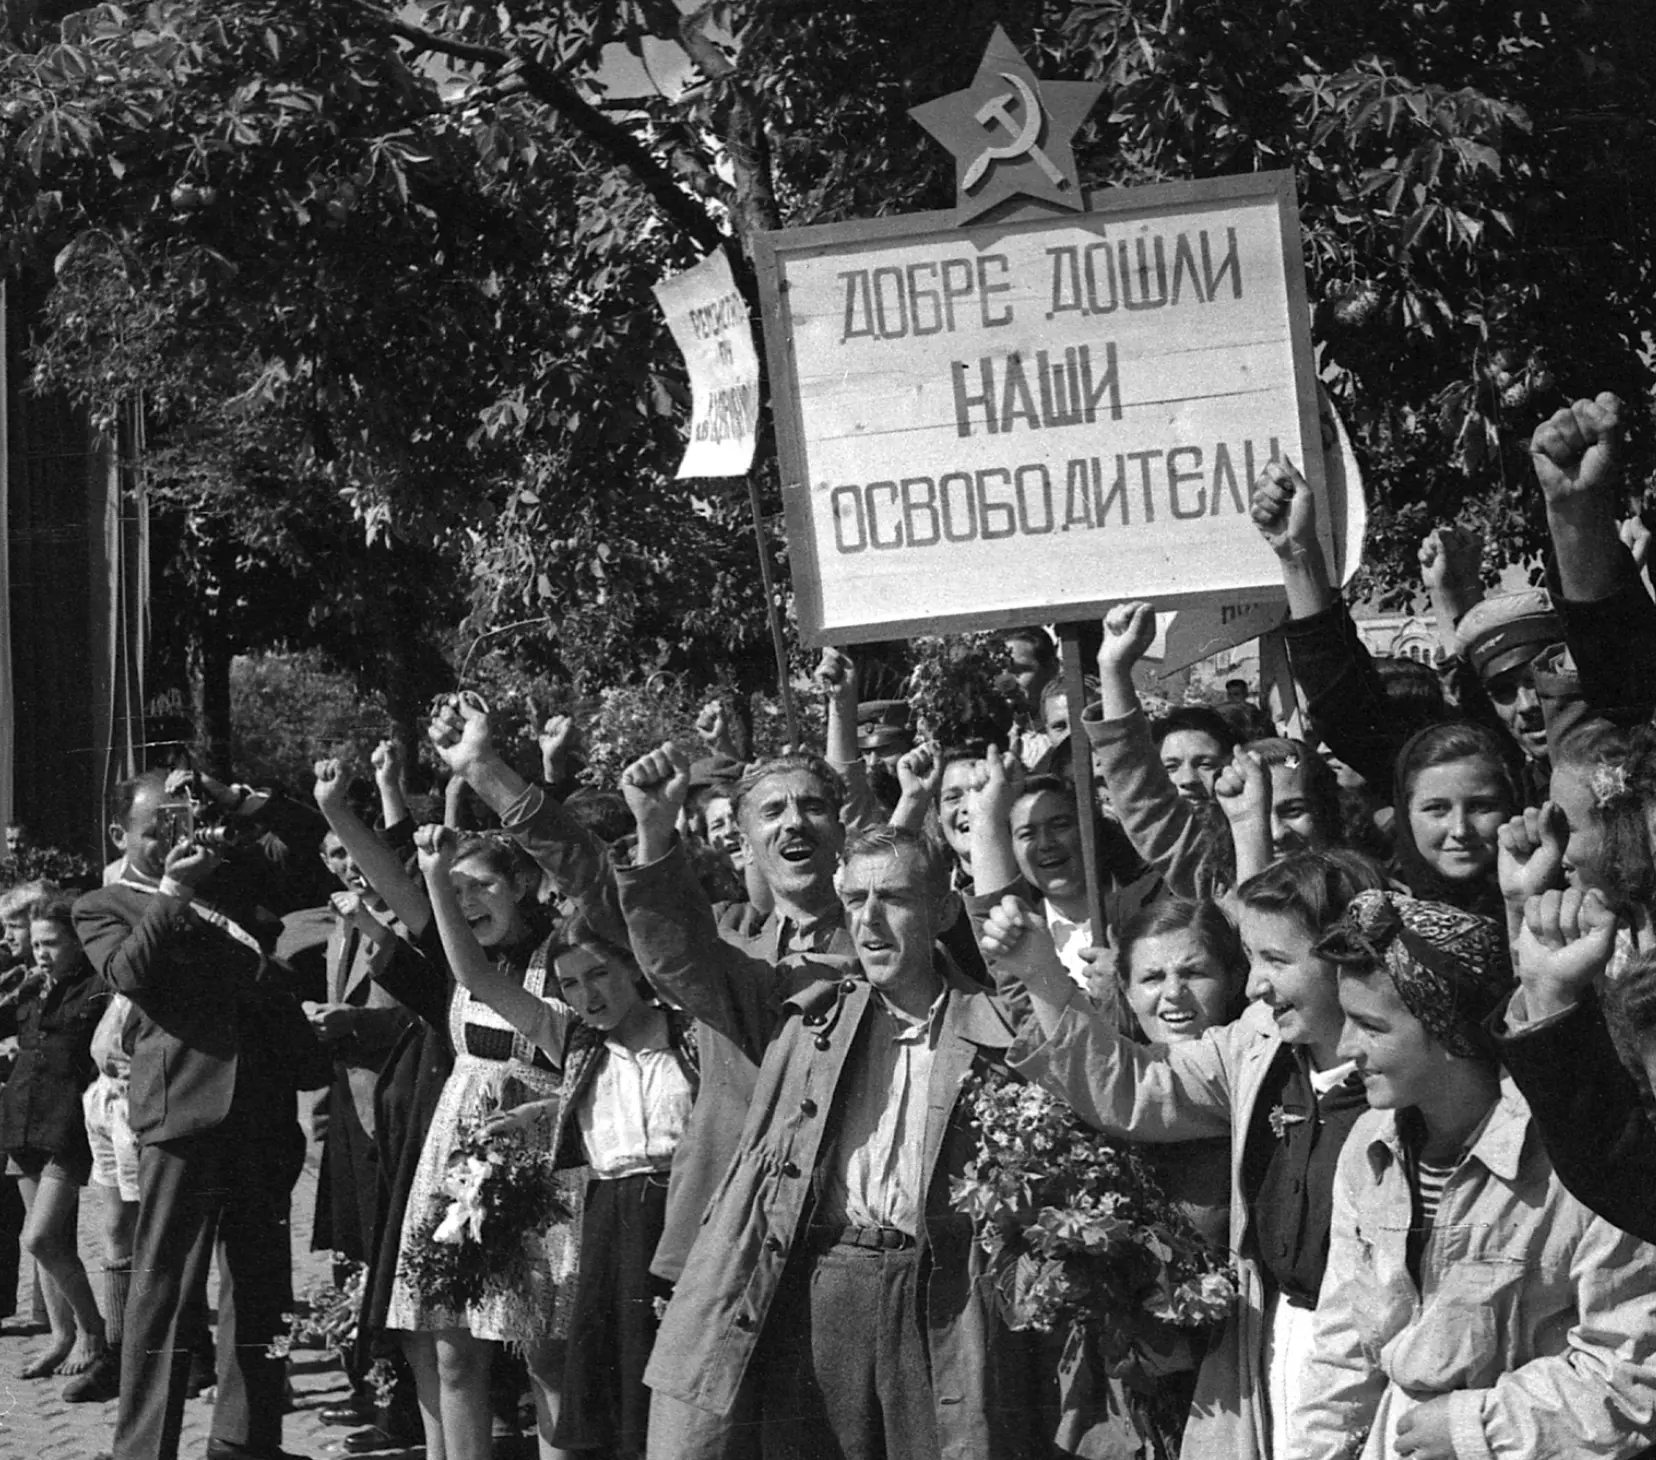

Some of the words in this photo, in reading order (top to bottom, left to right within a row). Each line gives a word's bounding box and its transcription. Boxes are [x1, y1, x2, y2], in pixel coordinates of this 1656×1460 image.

[838, 254, 1013, 344] ДОБРЕ
[1045, 227, 1242, 320] ДОШЛИ
[951, 341, 1123, 438] НАШИ
